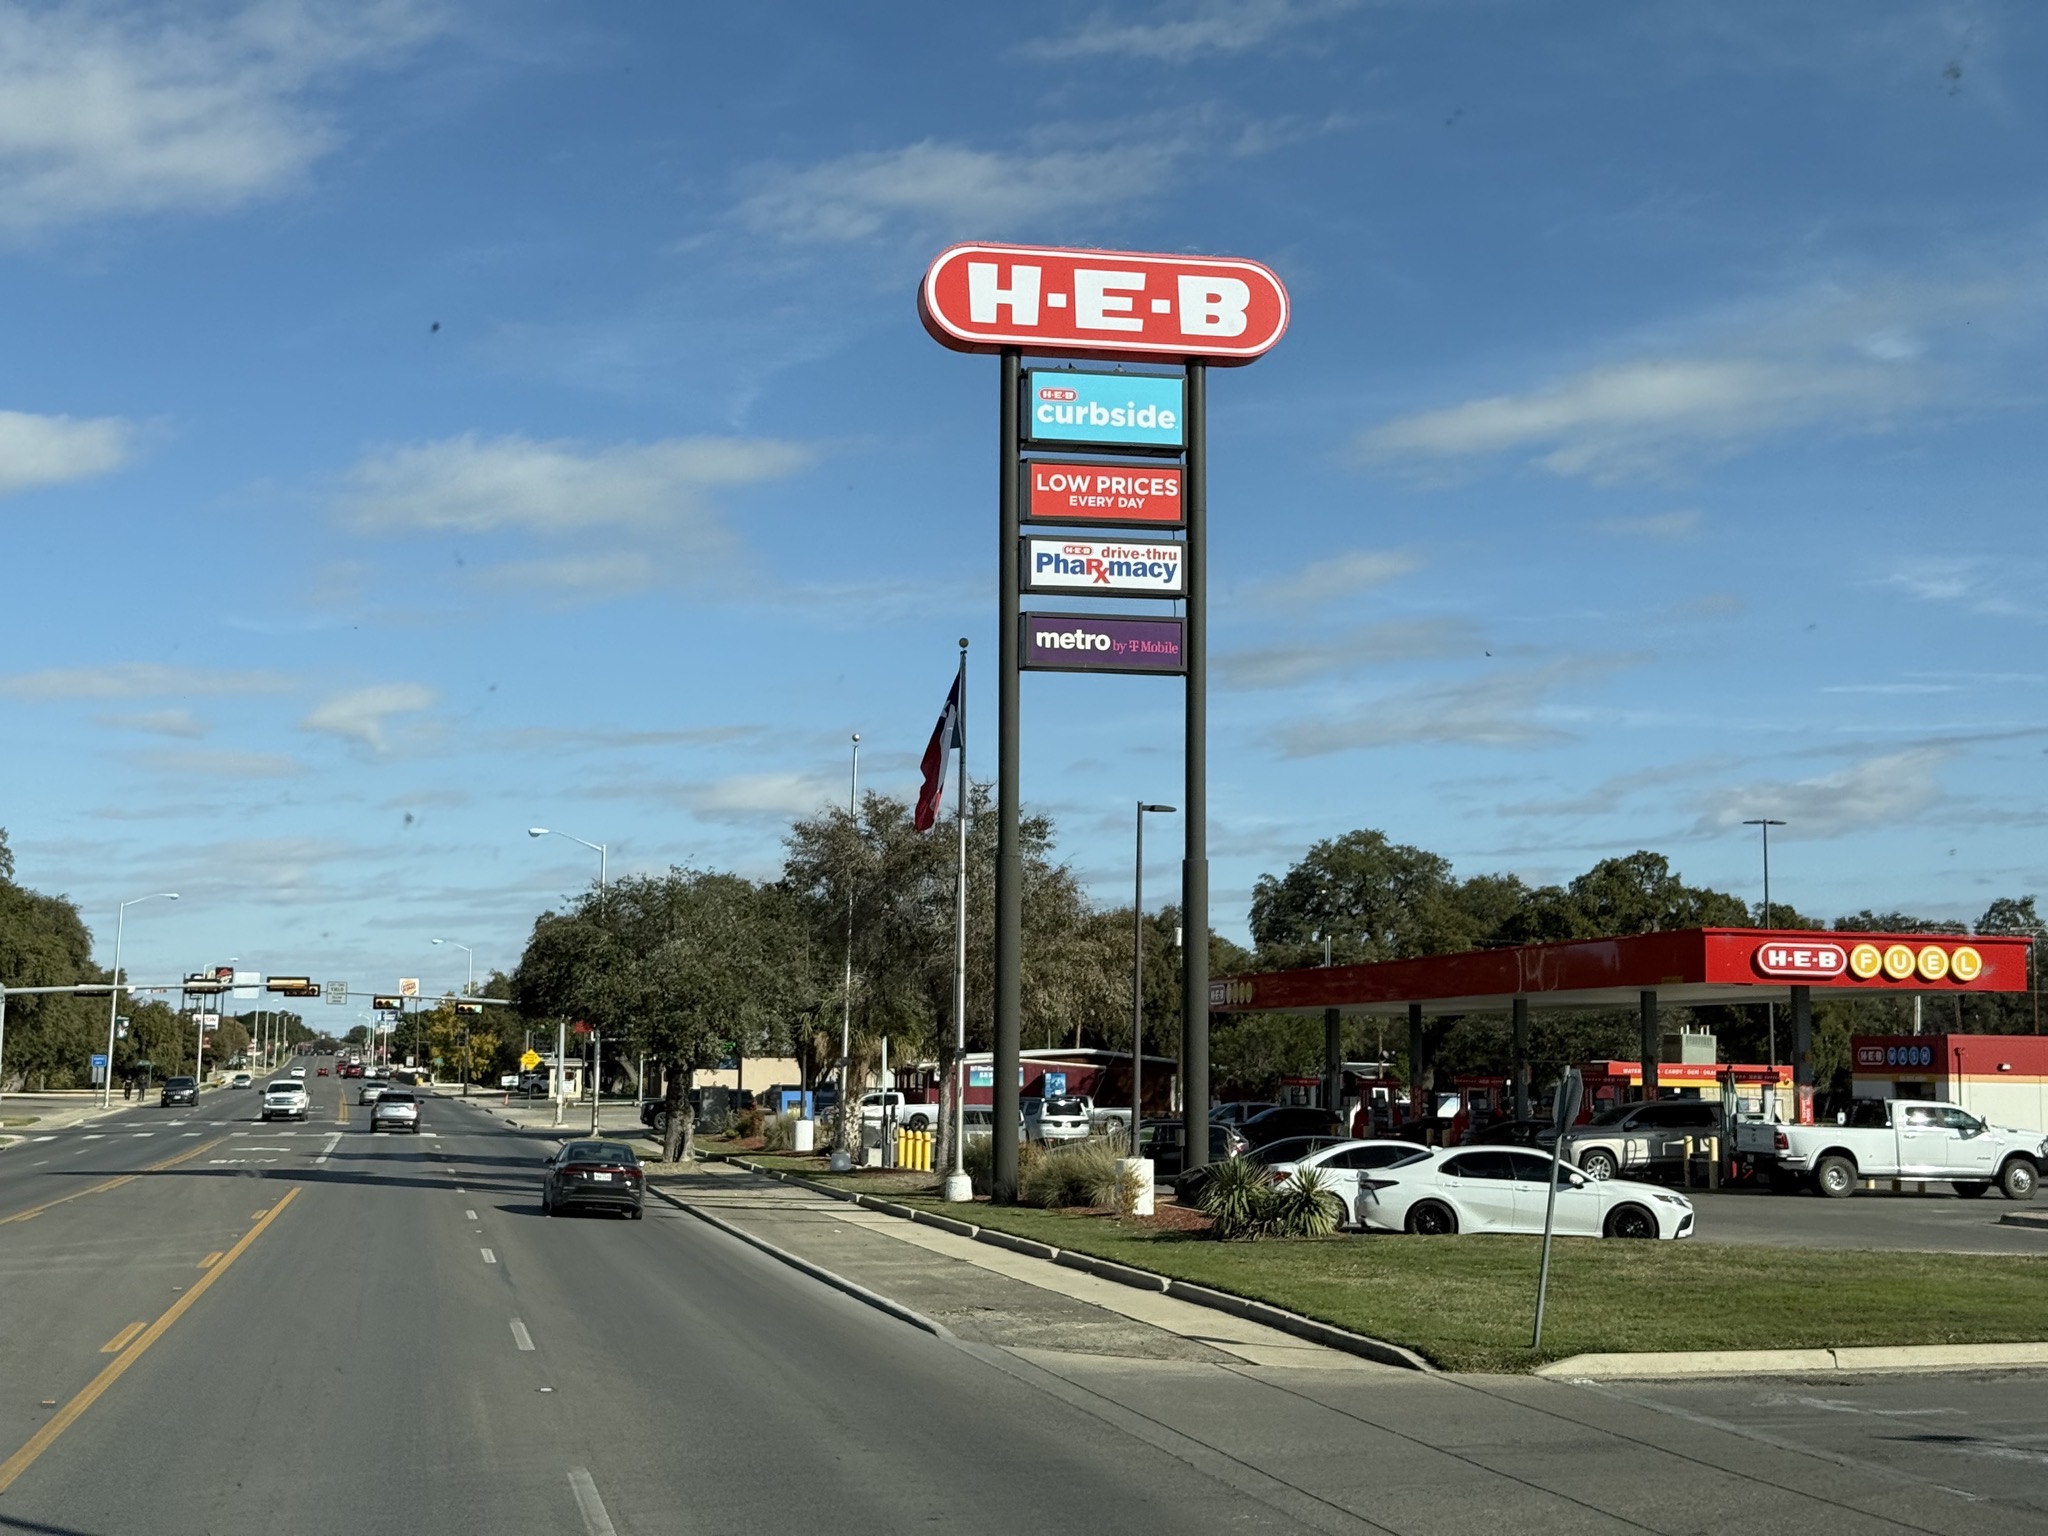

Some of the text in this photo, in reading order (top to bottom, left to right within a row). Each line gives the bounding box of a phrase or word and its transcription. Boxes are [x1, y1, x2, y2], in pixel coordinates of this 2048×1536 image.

[967, 261, 1251, 337] H-E-B
[1036, 400, 1177, 430] curbside
[1037, 473, 1179, 497] LOW PRICES
[1069, 495, 1146, 509] EVERY DAY
[1101, 546, 1177, 561] drive-thru
[1036, 629, 1112, 651] metro
[1113, 640, 1126, 655] by
[1141, 641, 1179, 655] Mobile
[1767, 949, 1975, 973] H-E-B FUEL
